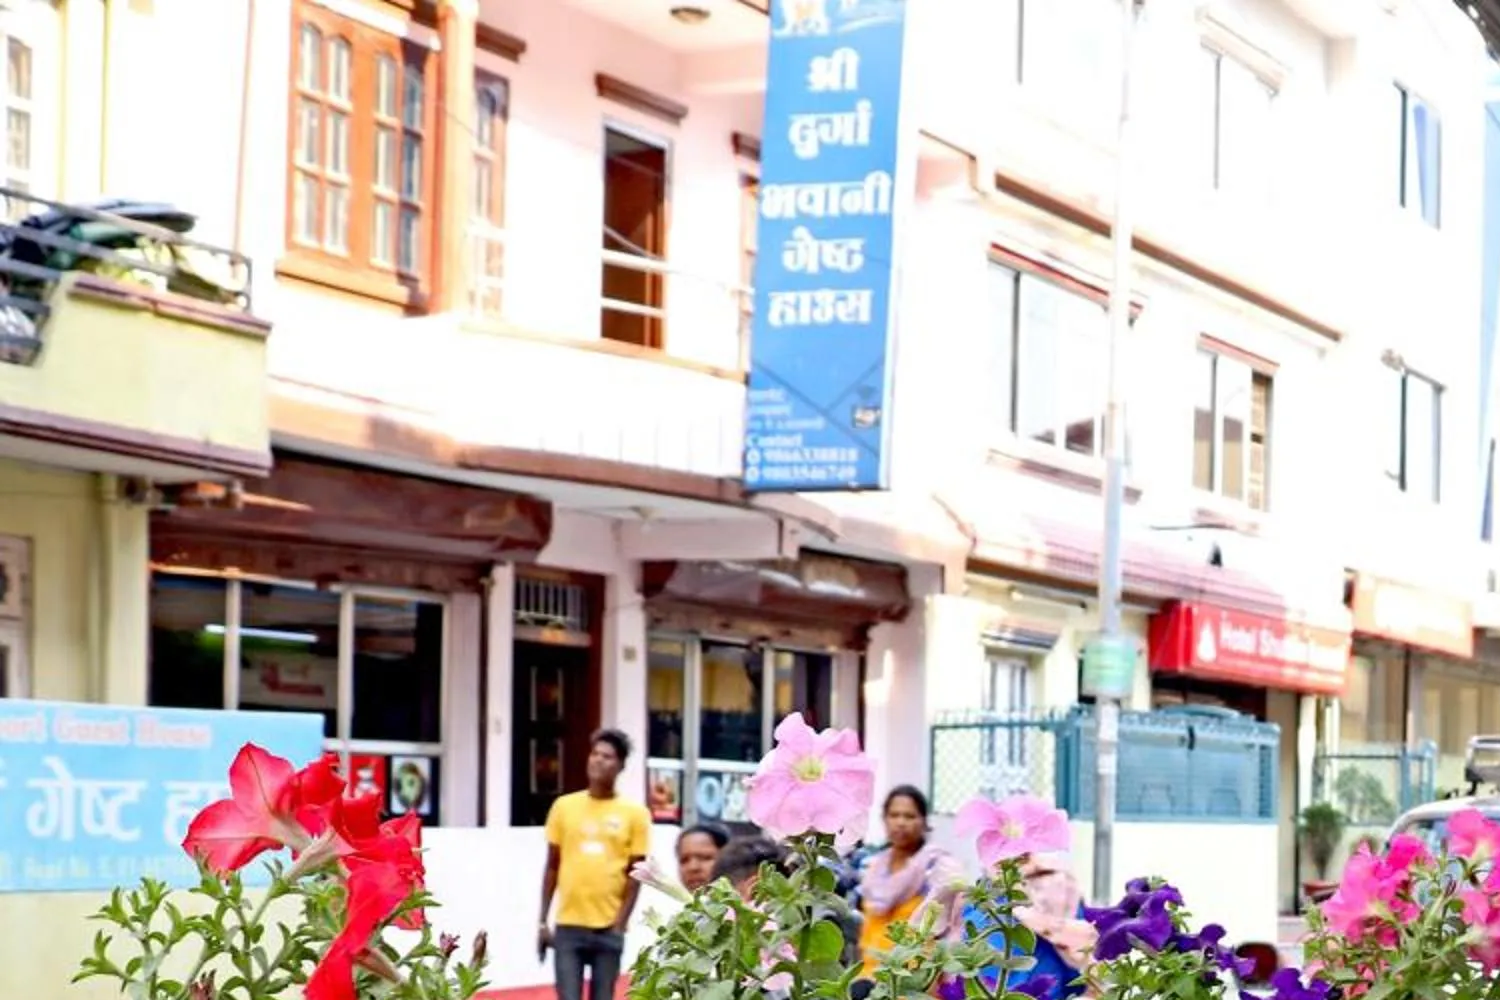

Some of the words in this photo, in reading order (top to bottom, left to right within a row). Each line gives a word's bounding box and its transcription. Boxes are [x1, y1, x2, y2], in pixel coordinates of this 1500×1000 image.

[808, 47, 860, 91] श्री
[788, 99, 872, 159] दुर्गा
[761, 170, 892, 219] भवानी
[768, 288, 872, 326] हाउस
[26, 756, 148, 841] गेष्ट
